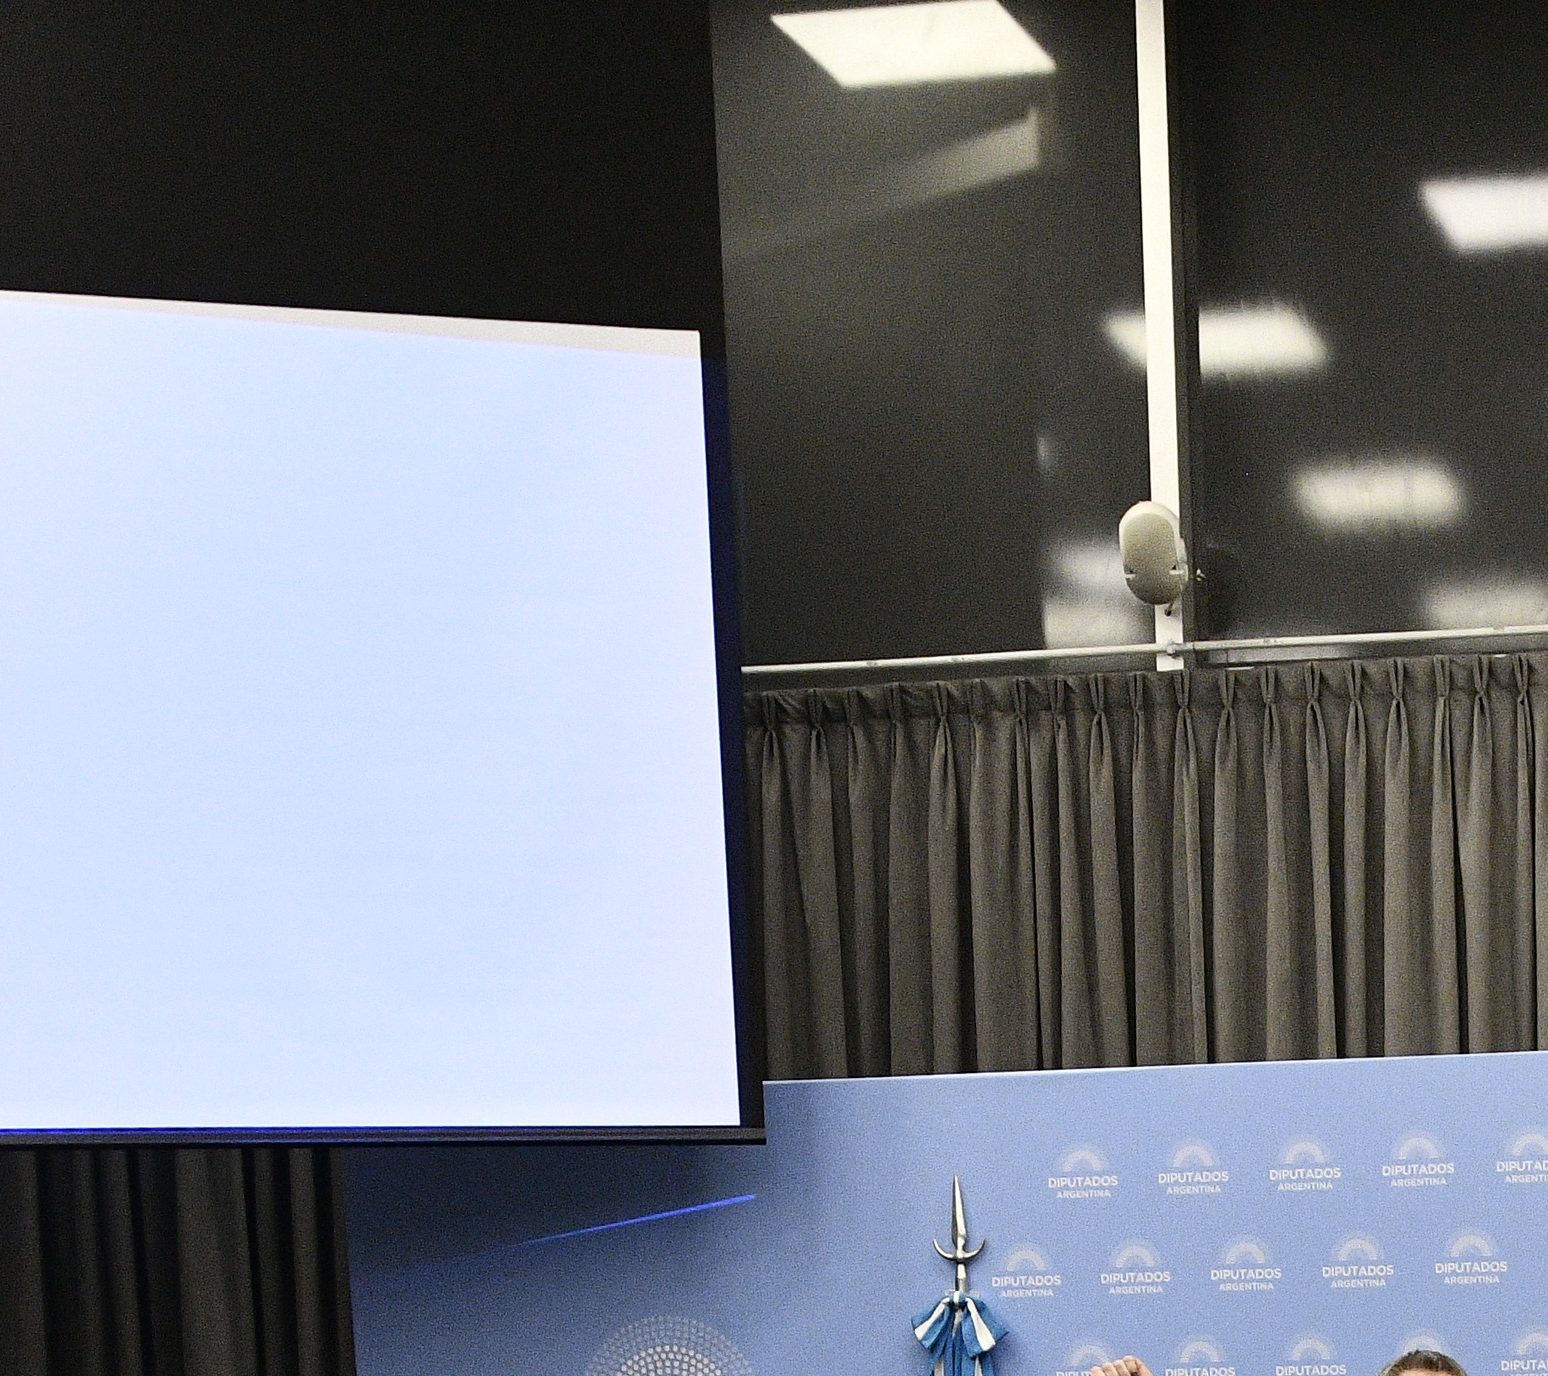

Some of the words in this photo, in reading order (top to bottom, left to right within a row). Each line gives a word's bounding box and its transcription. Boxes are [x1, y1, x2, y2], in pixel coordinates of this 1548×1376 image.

[1269, 1168, 1341, 1180] DIPUTADOS
[1382, 1163, 1454, 1176] DIPUTADOS
[1048, 1176, 1118, 1188] DIPUTADOS
[1158, 1171, 1229, 1183] DIPUTADOS
[1391, 1178, 1446, 1186] ARGENTINA
[1167, 1185, 1221, 1194] ARGENTINA
[1278, 1182, 1333, 1190] ARGENTINA
[1057, 1190, 1111, 1198] ARGENTINA
[1322, 1265, 1394, 1277] DIPUTADOS
[1435, 1261, 1508, 1273] DIPUTADOS
[1101, 1272, 1171, 1283] DIPUTADOS
[1211, 1268, 1282, 1280] DIPUTADOS
[1444, 1275, 1499, 1284] ARGENTINA
[992, 1275, 1061, 1287] DIPUTADOS
[1331, 1279, 1385, 1287] ARGENTINA
[1001, 1289, 1053, 1297] ARGENTINA
[1109, 1286, 1163, 1294] ARGENTINA
[1276, 1365, 1347, 1376] DIPUTADOS
